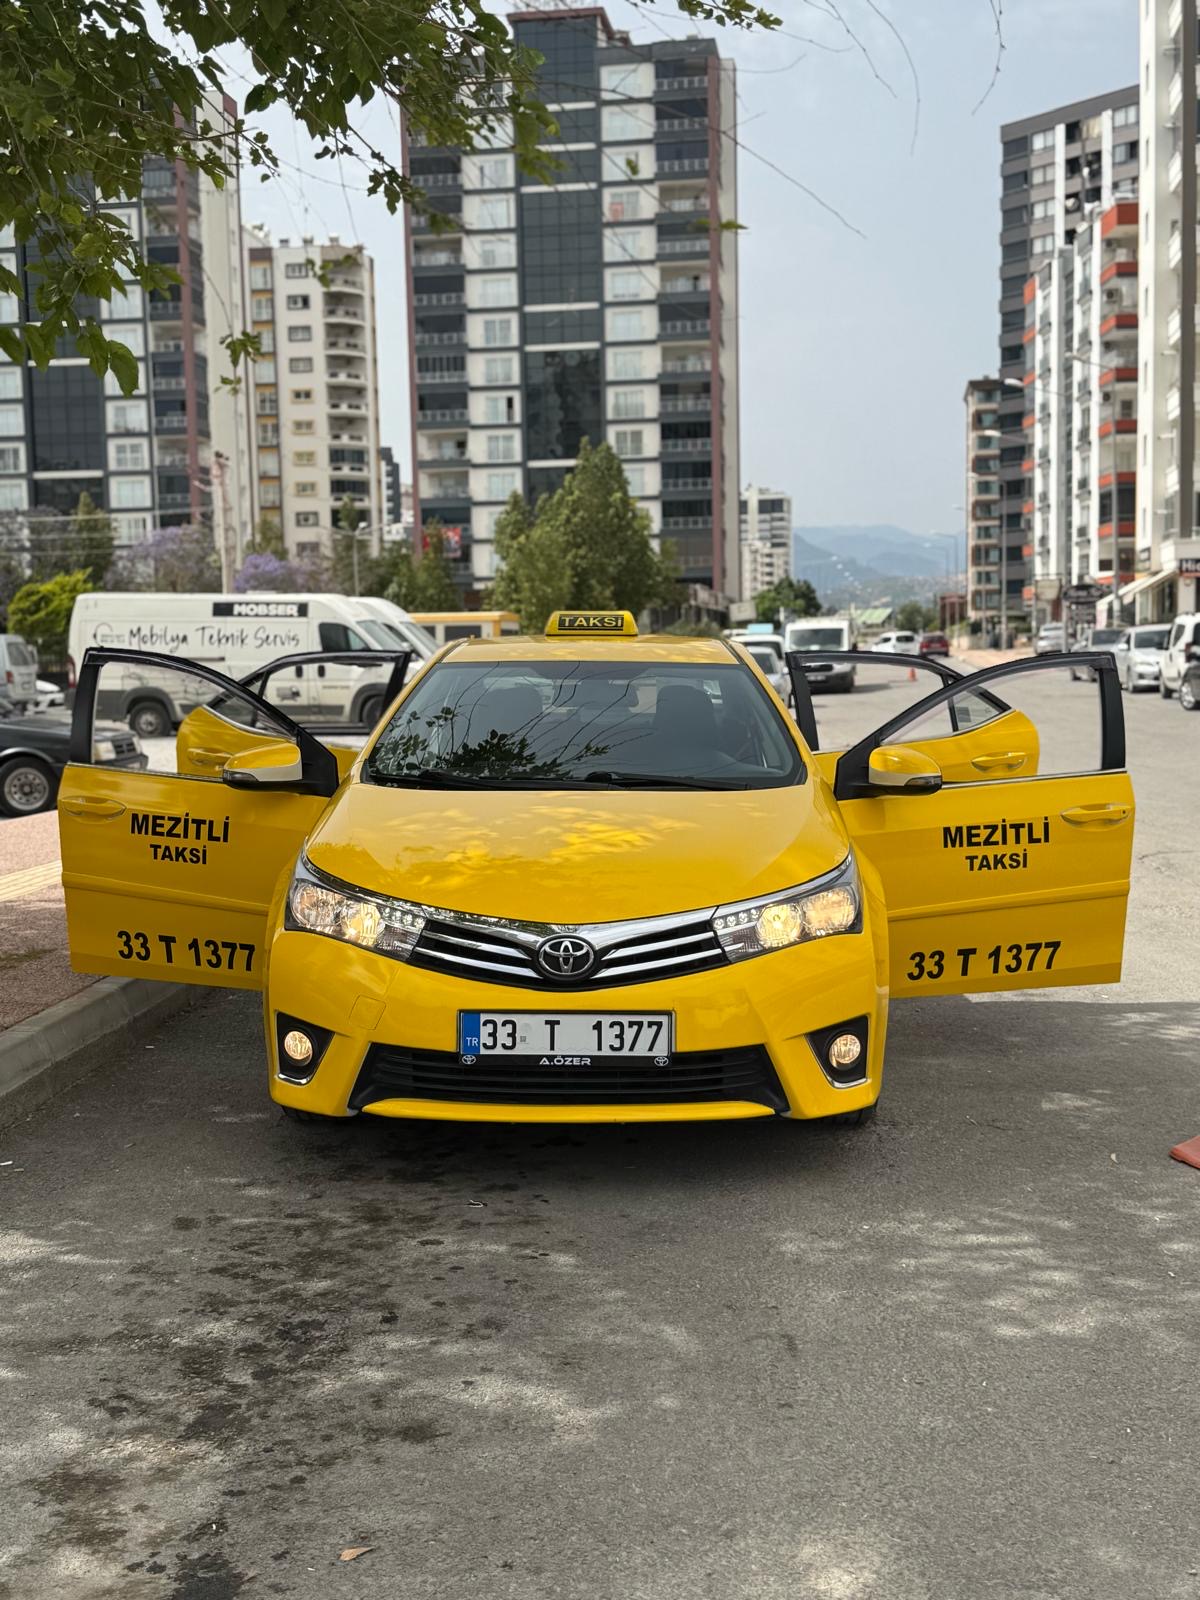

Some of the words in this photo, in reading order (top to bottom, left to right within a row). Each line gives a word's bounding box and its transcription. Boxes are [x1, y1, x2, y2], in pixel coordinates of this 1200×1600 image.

[233, 604, 299, 615] MOBSER
[128, 626, 189, 653] Mobilya
[195, 626, 249, 647] Teknik
[254, 626, 300, 649] Servis
[130, 812, 230, 843] MEZİTLİ
[942, 816, 1050, 849] MEZİTLİ
[149, 844, 207, 865] TAKSİ
[965, 848, 1028, 872] TAKSİ
[117, 930, 151, 961] 33
[158, 934, 177, 964] T
[188, 938, 256, 972] 1377
[907, 950, 945, 981] 33
[956, 947, 977, 977] T
[987, 940, 1062, 975] 1377
[466, 1037, 479, 1047] TR
[482, 1019, 517, 1050] 33
[544, 1019, 561, 1051] T
[592, 1020, 664, 1052] 1377
